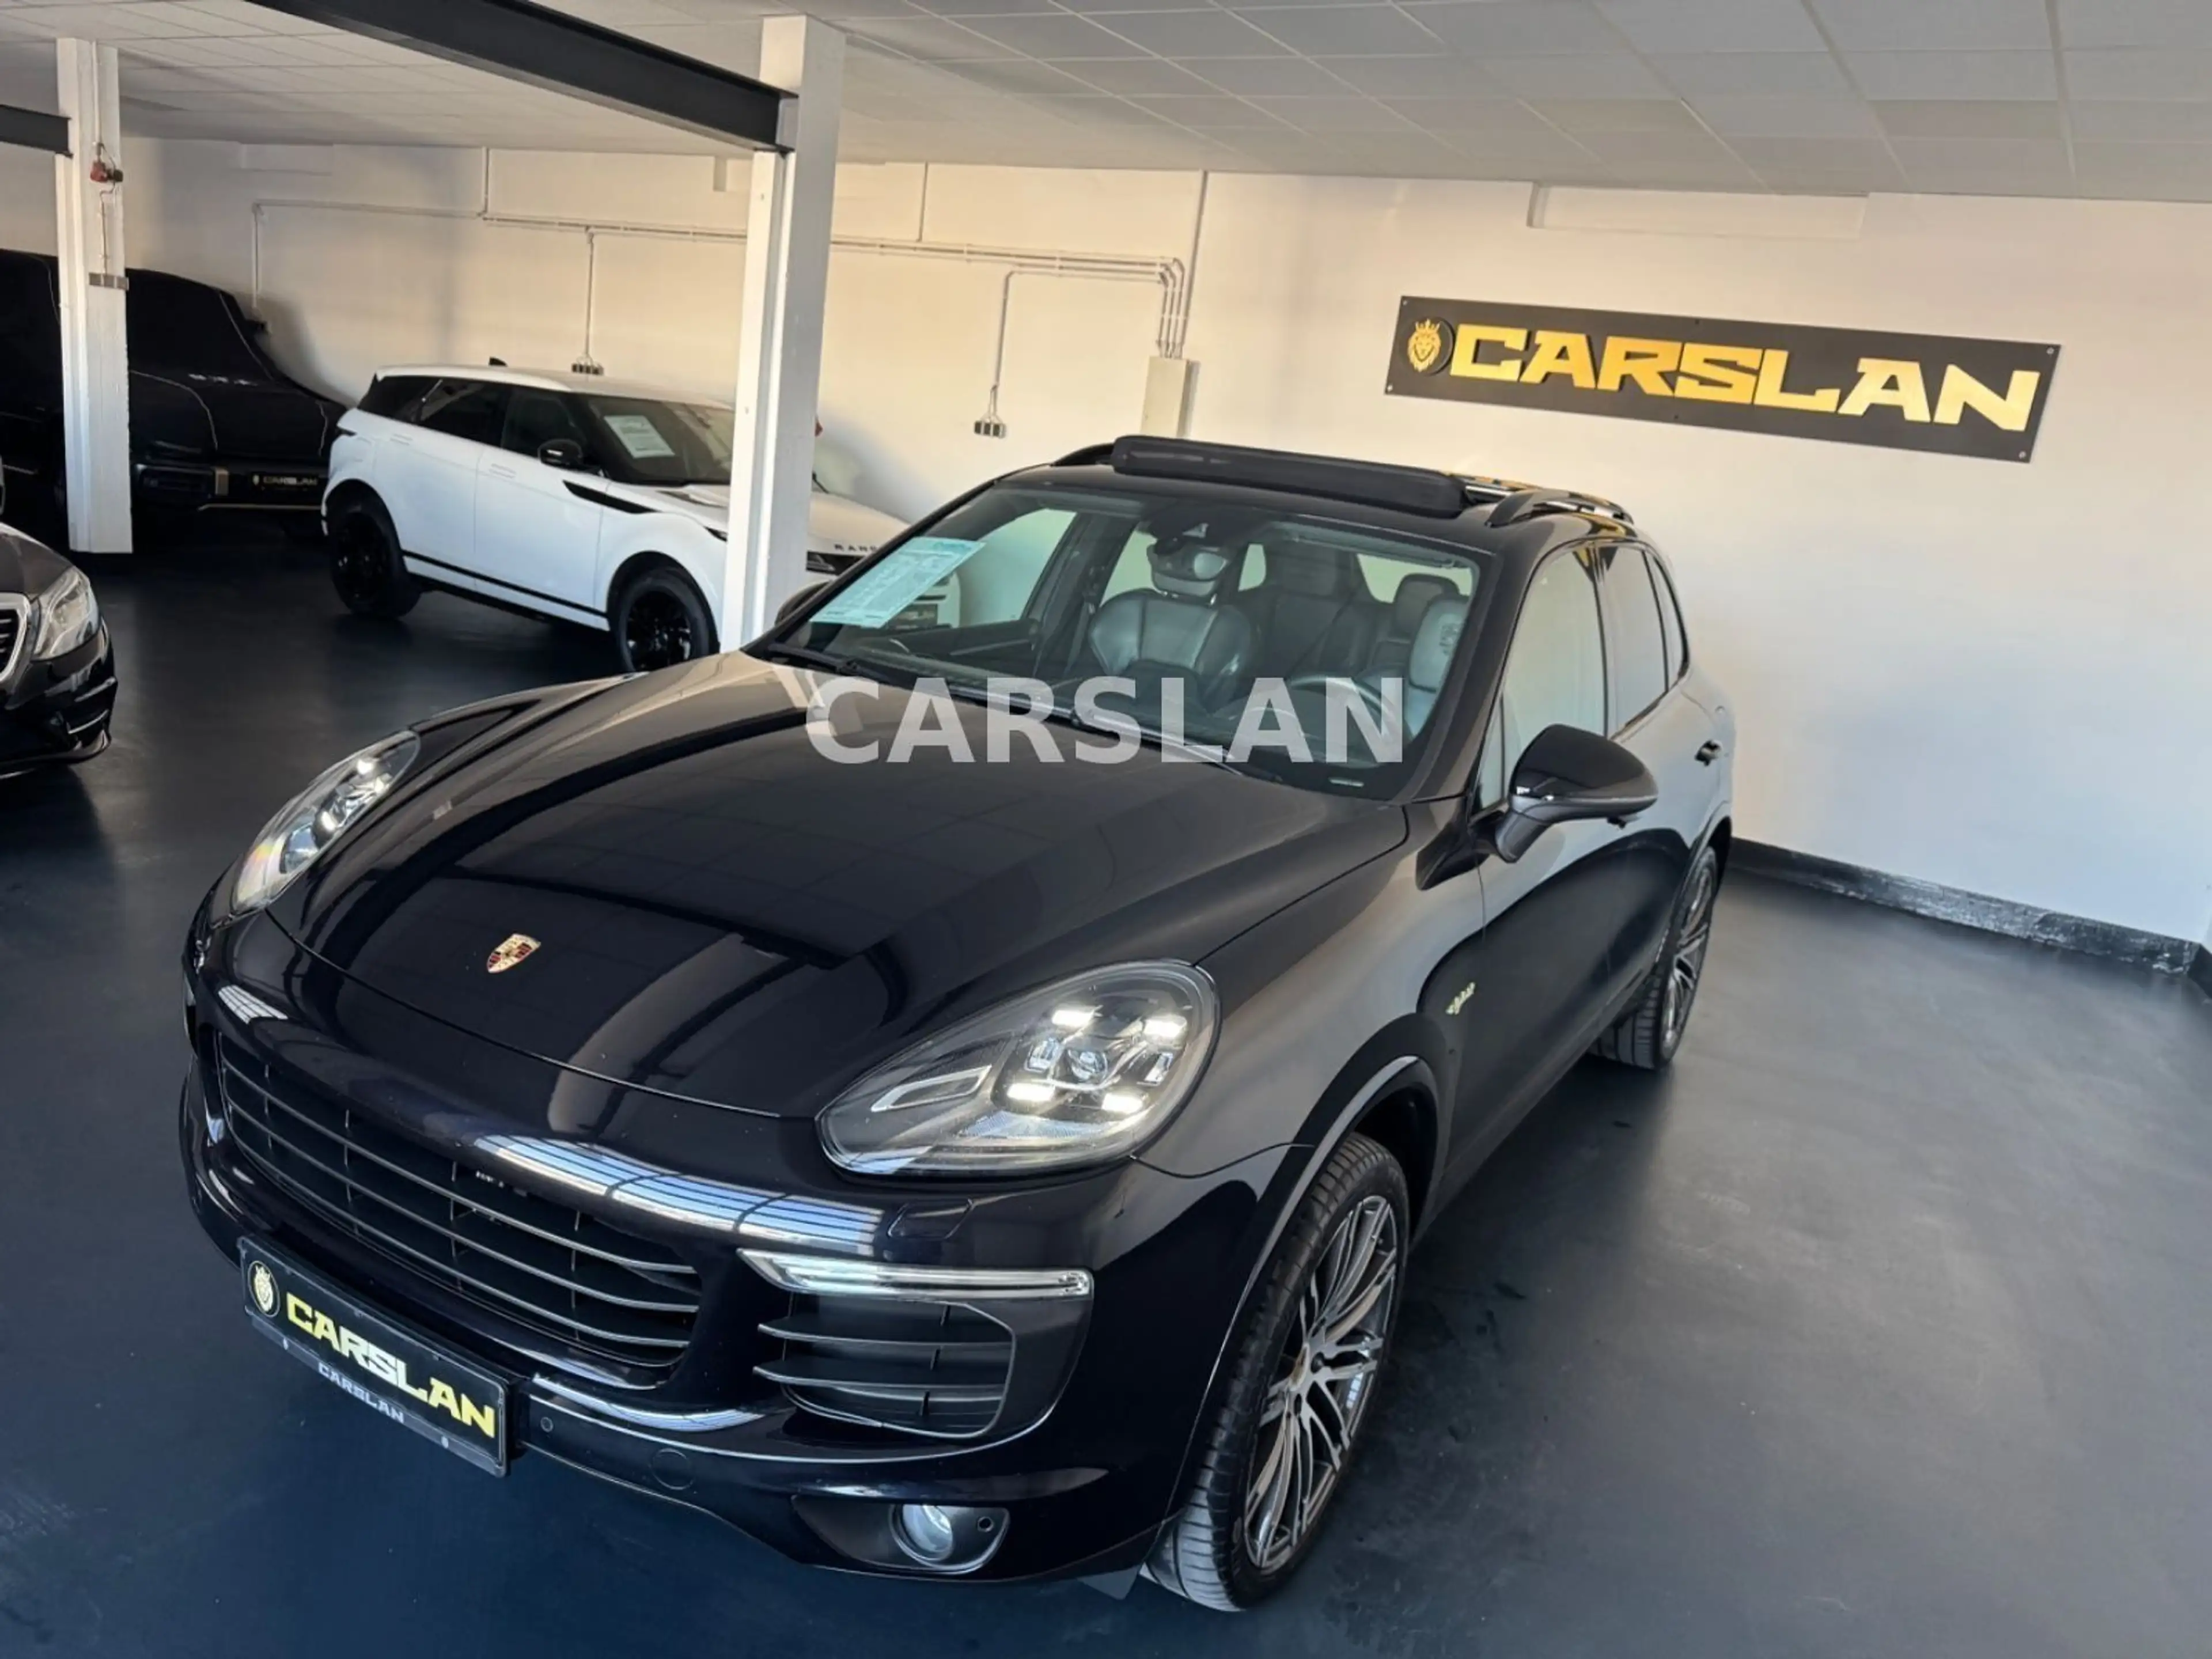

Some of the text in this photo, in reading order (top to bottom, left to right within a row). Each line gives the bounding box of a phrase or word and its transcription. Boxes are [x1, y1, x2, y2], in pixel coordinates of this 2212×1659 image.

[1450, 324, 2040, 431] CARSLAN
[287, 1292, 495, 1438] CARSLAN
[319, 1362, 404, 1423] CARSLAN
